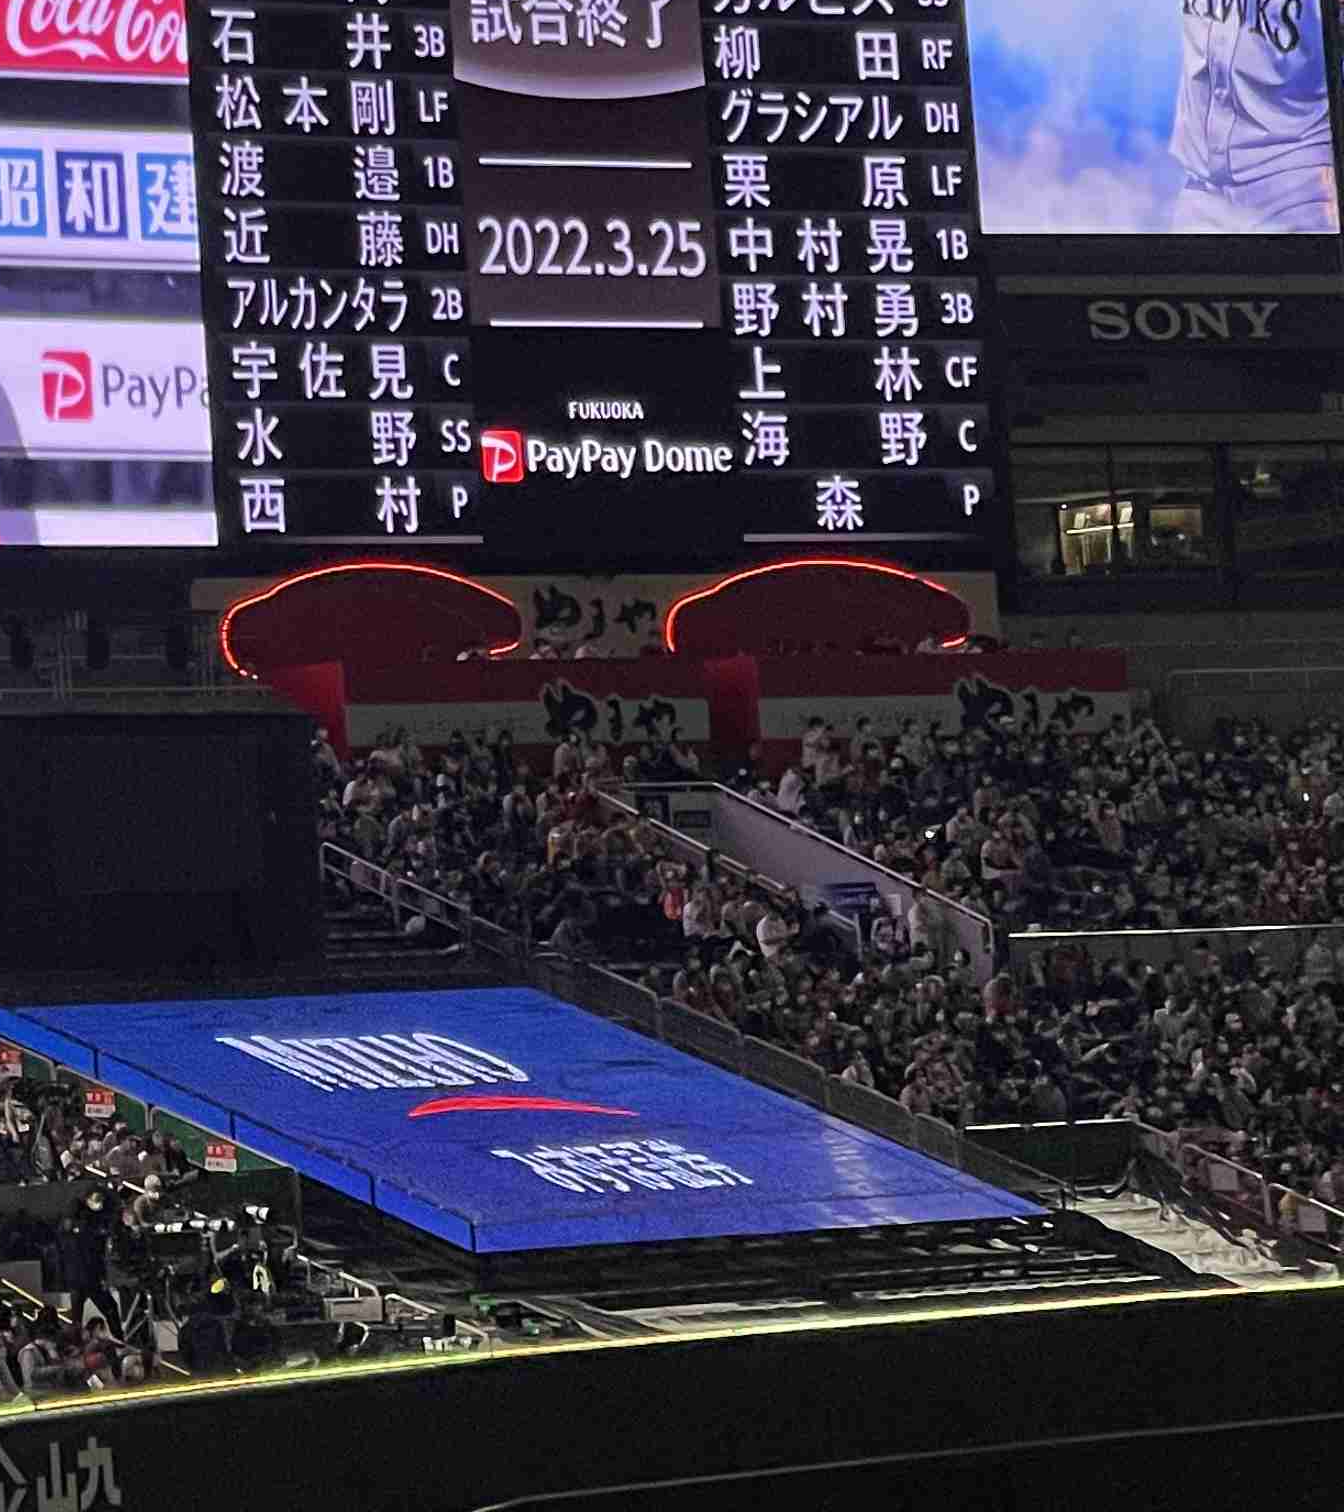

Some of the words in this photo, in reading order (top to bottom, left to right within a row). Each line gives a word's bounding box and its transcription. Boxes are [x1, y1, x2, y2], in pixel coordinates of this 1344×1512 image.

[414, 24, 446, 58] 3B
[922, 38, 953, 70] RF
[215, 73, 396, 136] 松本剛
[418, 90, 449, 123] LF
[721, 88, 904, 144] グラシアル
[925, 102, 960, 133] DH
[423, 156, 455, 188] 1B
[931, 165, 962, 197] LF
[426, 222, 459, 255] DH
[478, 216, 707, 278] 2022.3.25
[729, 217, 914, 274] 中村晃
[936, 229, 969, 261] 1B
[227, 276, 408, 333] アルカンタラ
[432, 288, 463, 320] 2B
[732, 282, 919, 338] 野村勇
[940, 292, 974, 324] 3B
[1087, 300, 1280, 341] SONY
[232, 340, 414, 401] 宇佐見
[443, 353, 461, 386] C
[944, 356, 978, 388] CF
[568, 400, 645, 420] FUKUOKA
[441, 420, 472, 453] SS
[958, 420, 977, 452] C
[527, 438, 636, 479] PayPay
[644, 439, 733, 473] Dome
[452, 486, 469, 519] P
[816, 474, 864, 531] 森
[963, 484, 981, 516] P
